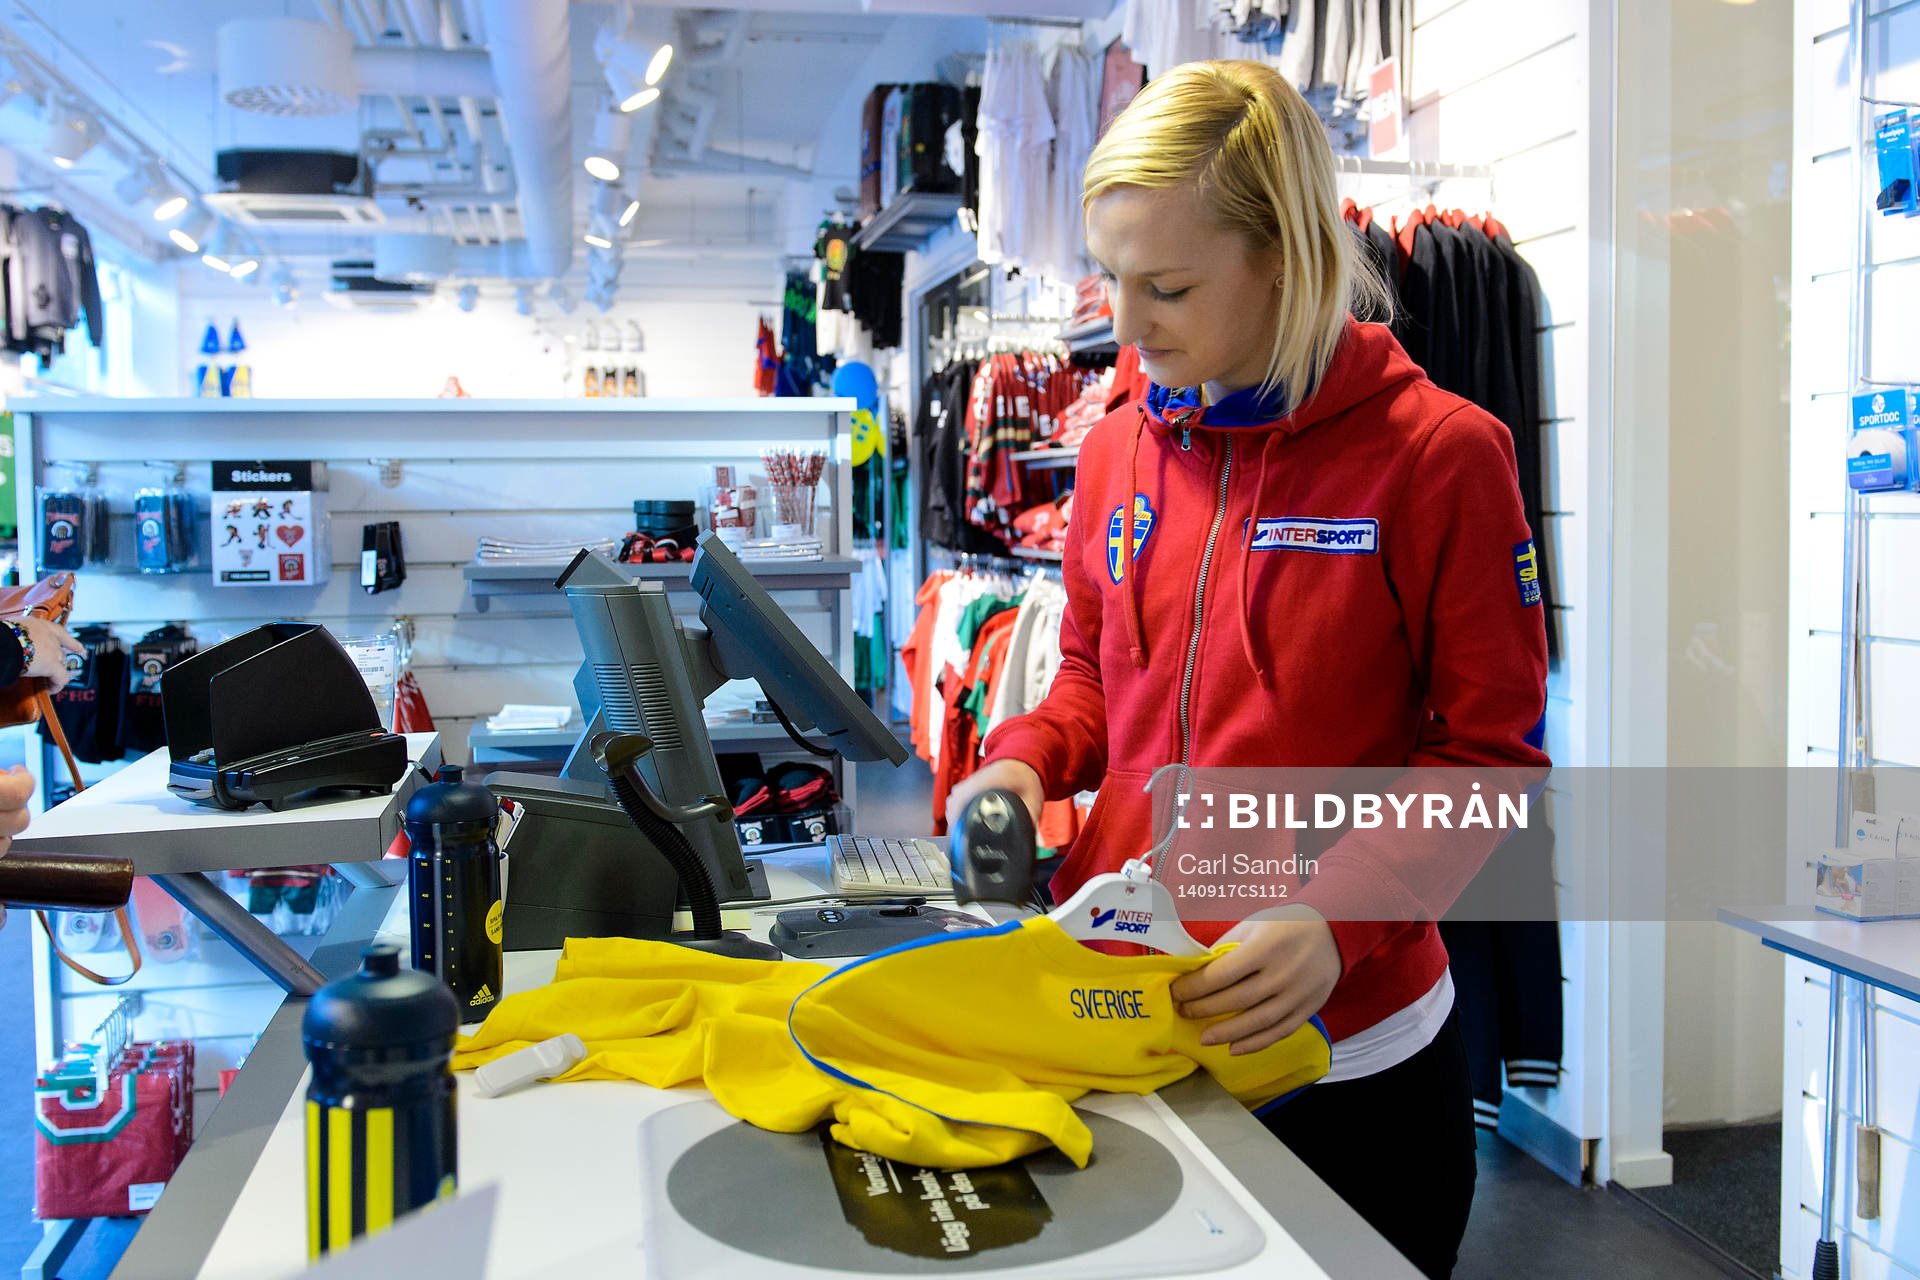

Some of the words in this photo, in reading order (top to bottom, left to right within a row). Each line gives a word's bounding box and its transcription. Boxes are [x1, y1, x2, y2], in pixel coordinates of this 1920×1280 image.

[1859, 411, 1900, 426] SPORTDOC
[231, 469, 292, 483] Stickers
[1267, 527, 1365, 545] INTERSPORT
[1114, 921, 1150, 934] SPORT
[469, 995, 495, 1007] adidas
[948, 1172, 975, 1194] den
[954, 1193, 990, 1210] på
[930, 1199, 955, 1222] inte
[940, 1220, 970, 1252] Lägg
